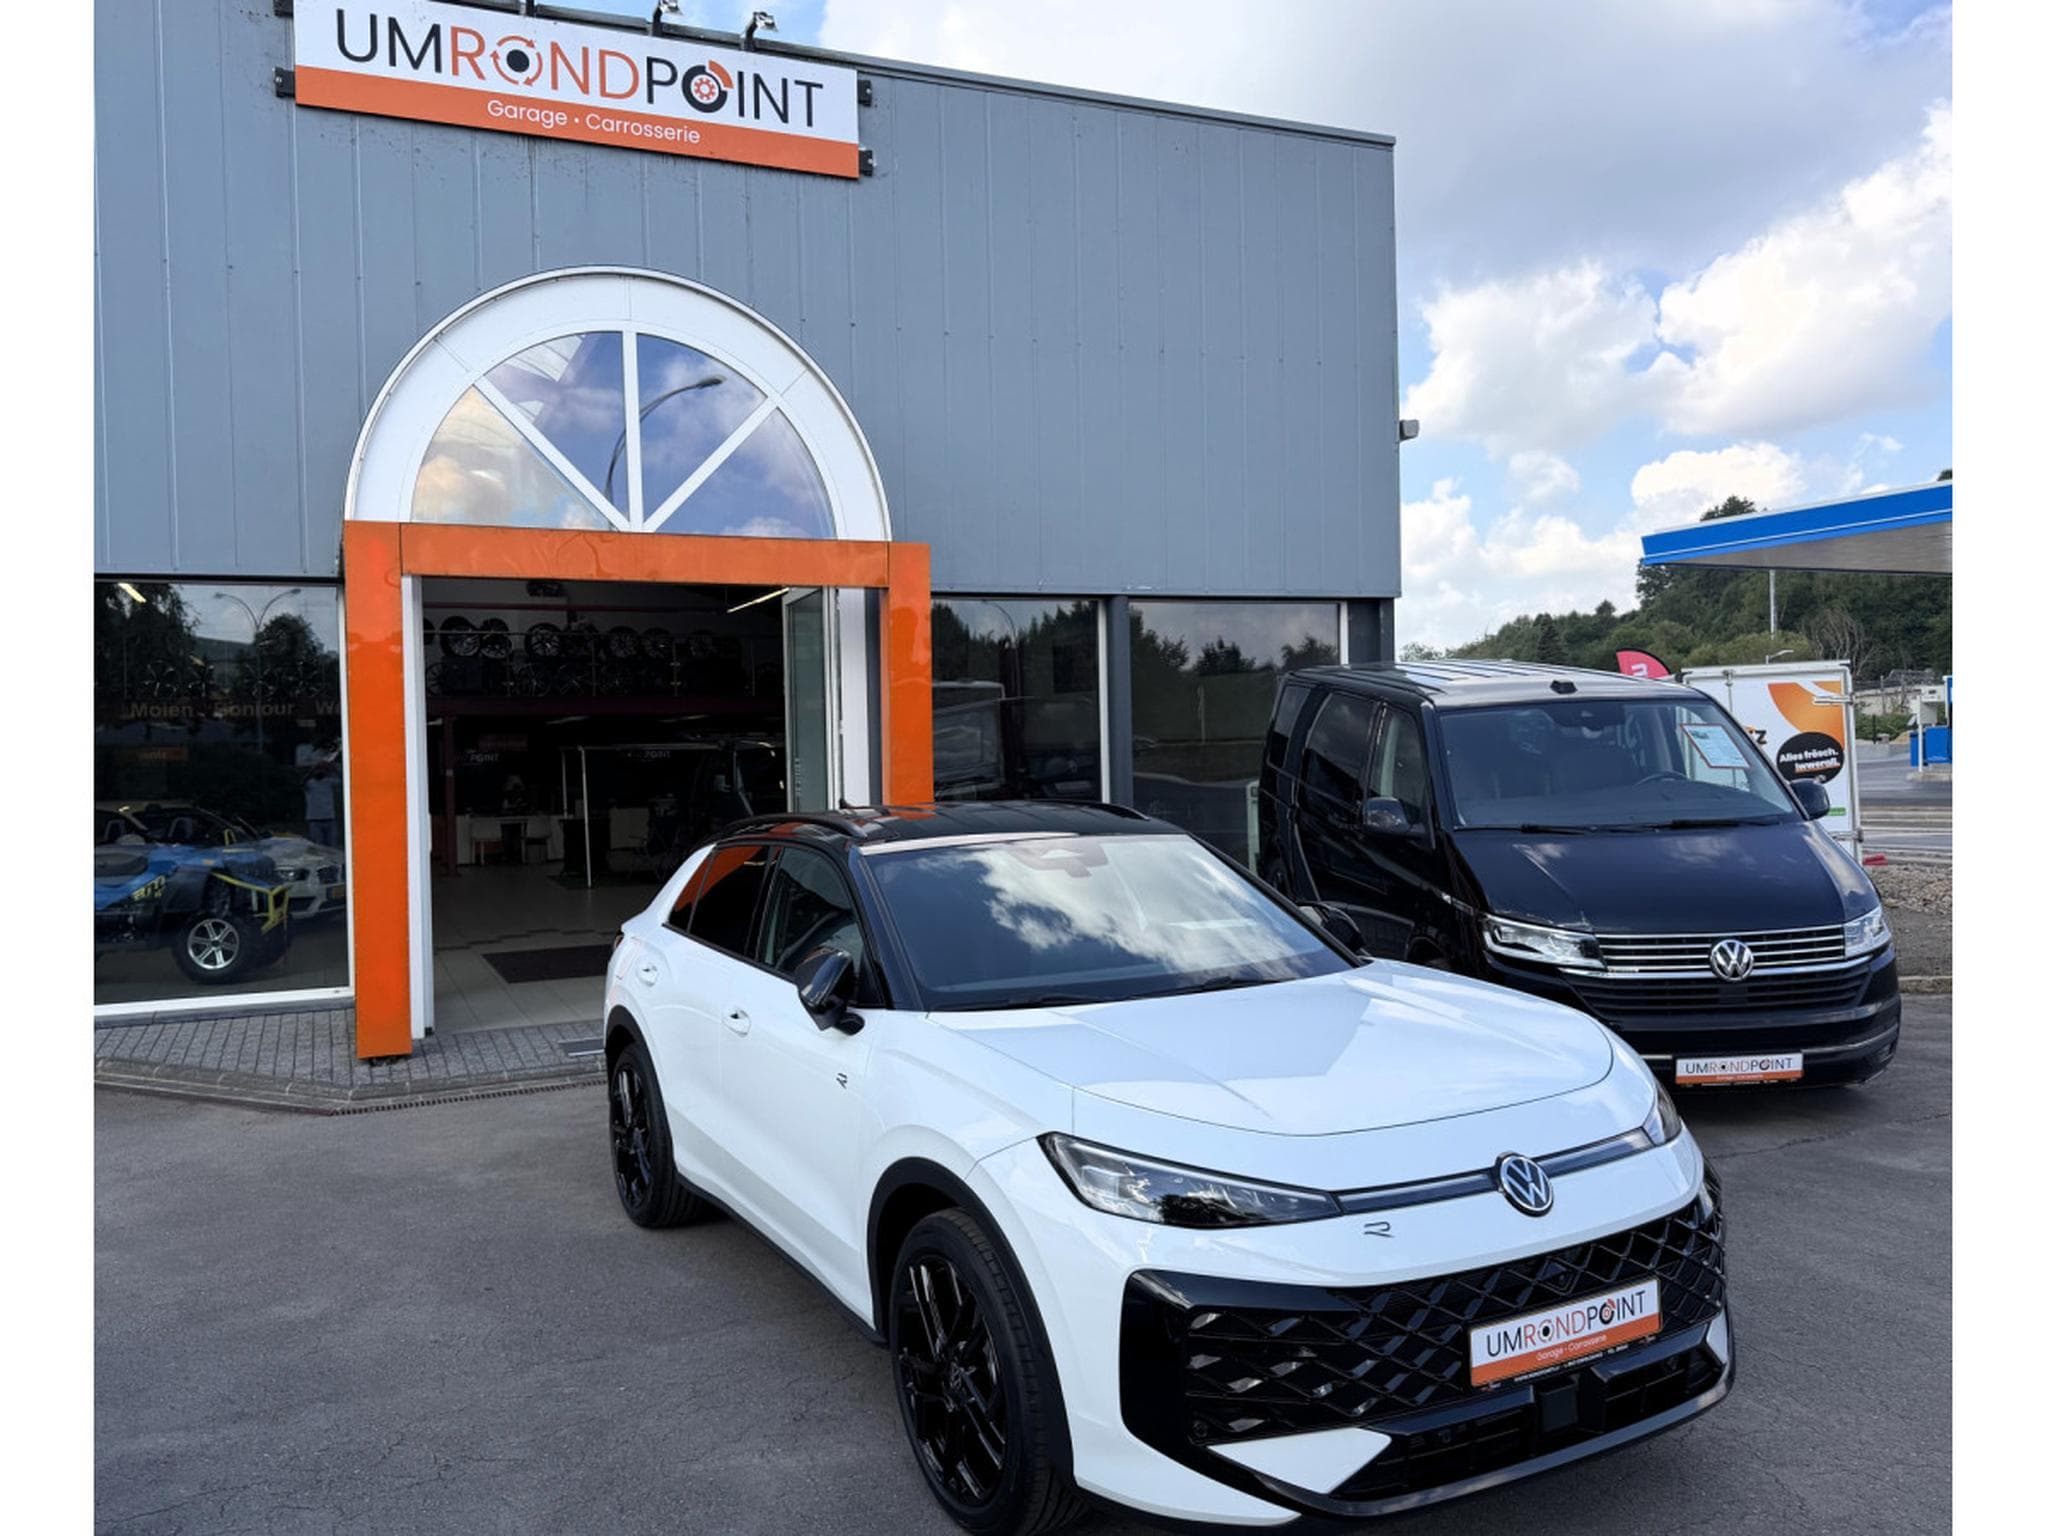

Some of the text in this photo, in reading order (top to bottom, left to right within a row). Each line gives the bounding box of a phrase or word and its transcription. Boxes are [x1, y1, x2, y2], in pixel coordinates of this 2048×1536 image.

[335, 8, 824, 128] UMRONDPOINT
[486, 99, 702, 145] Garage Carrosserie
